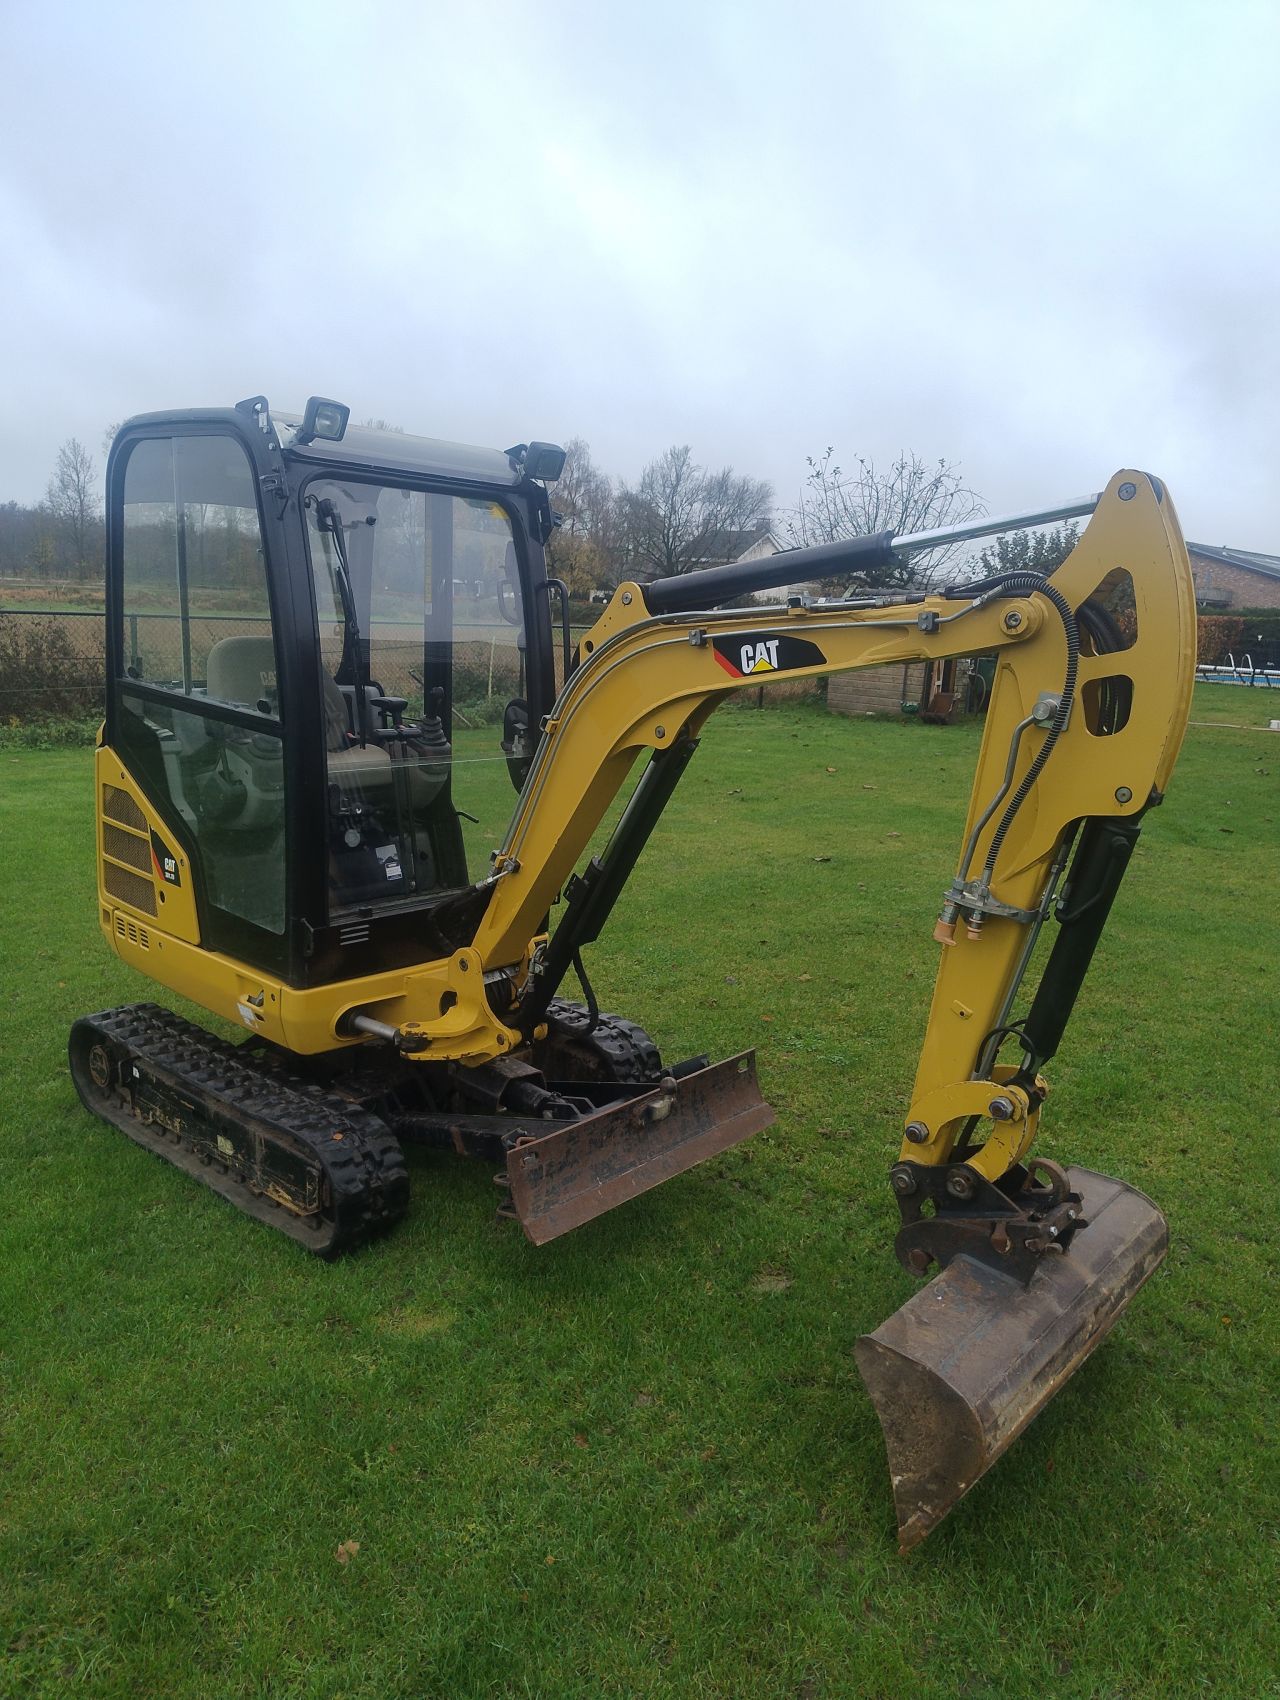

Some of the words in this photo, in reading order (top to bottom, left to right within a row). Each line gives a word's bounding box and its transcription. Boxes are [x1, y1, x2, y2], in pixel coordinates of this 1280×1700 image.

[740, 639, 780, 674] CAT
[259, 671, 277, 685] CA
[164, 857, 176, 872] CAT
